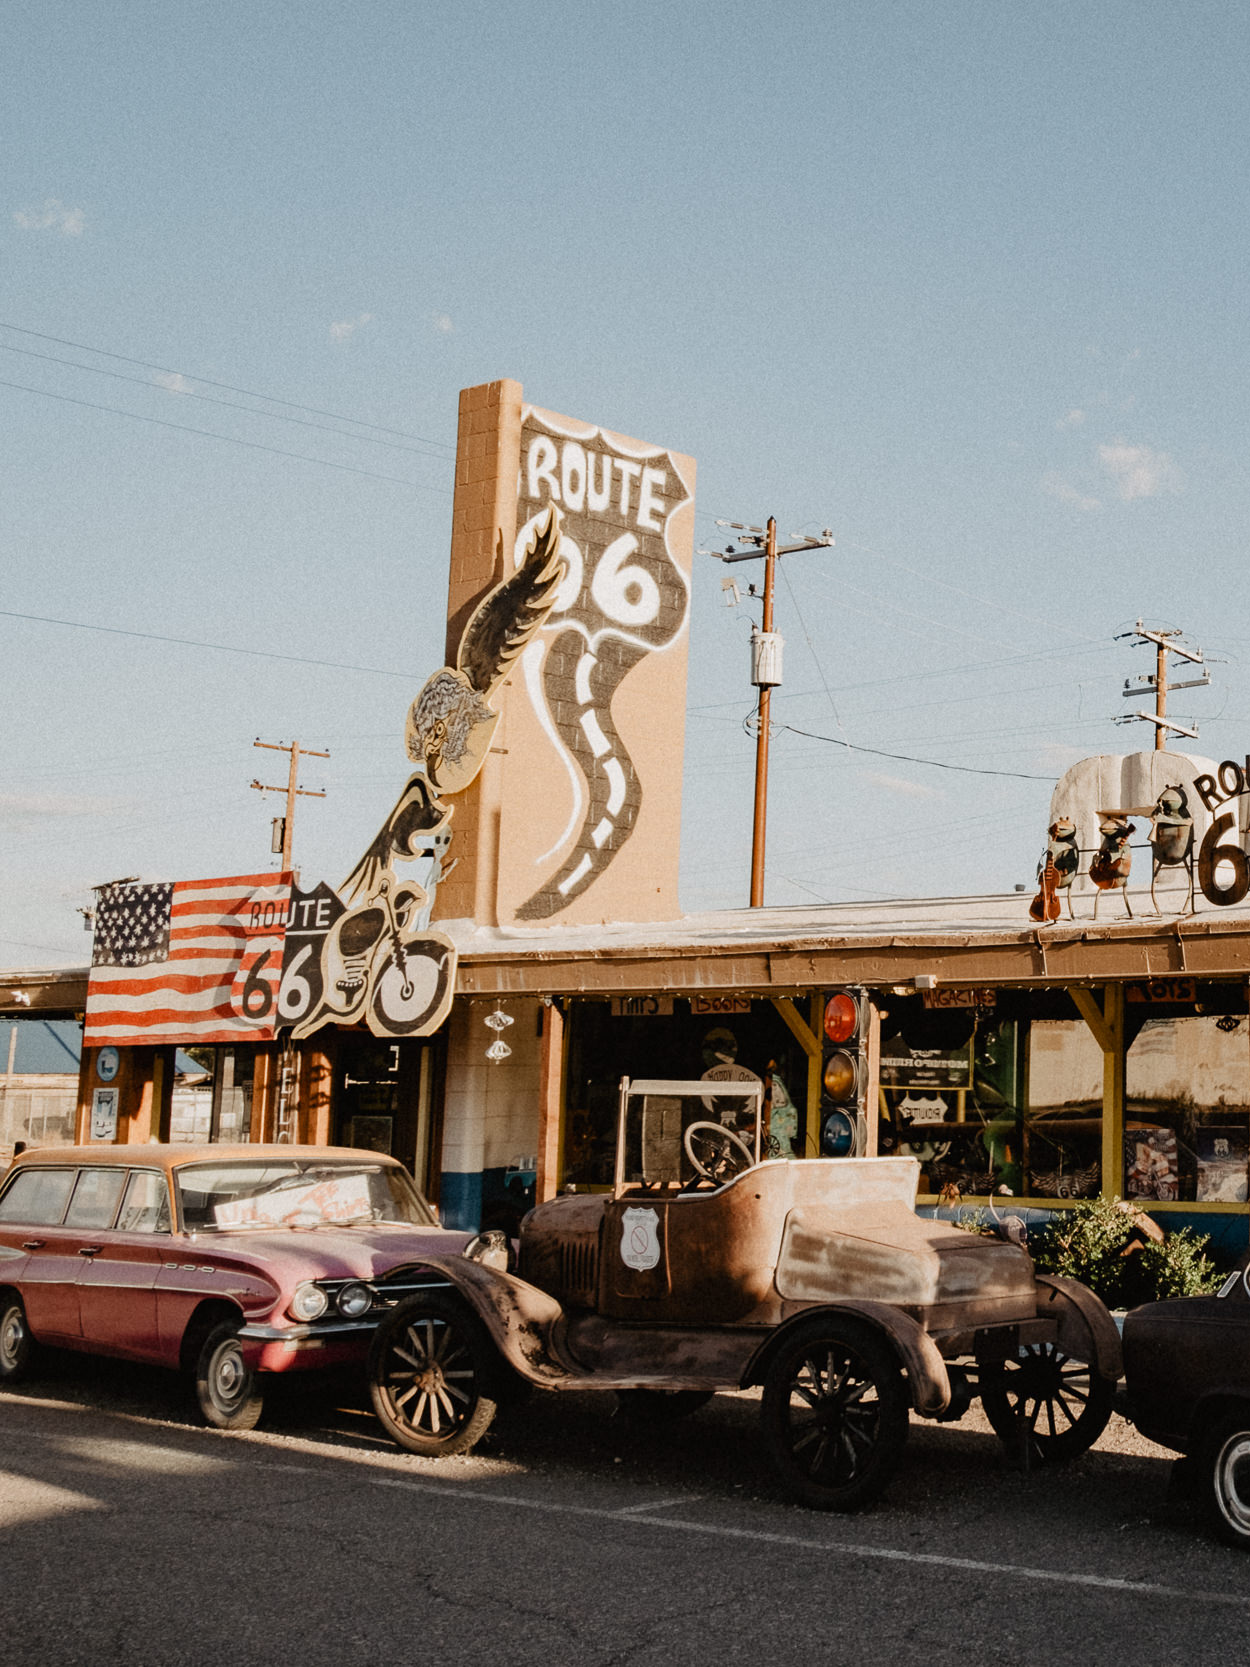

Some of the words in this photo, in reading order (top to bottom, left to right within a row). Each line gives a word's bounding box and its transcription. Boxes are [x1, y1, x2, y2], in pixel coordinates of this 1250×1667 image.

[527, 436, 667, 533] ROUTE
[250, 898, 331, 930] ROUTE
[242, 944, 311, 1019] 66
